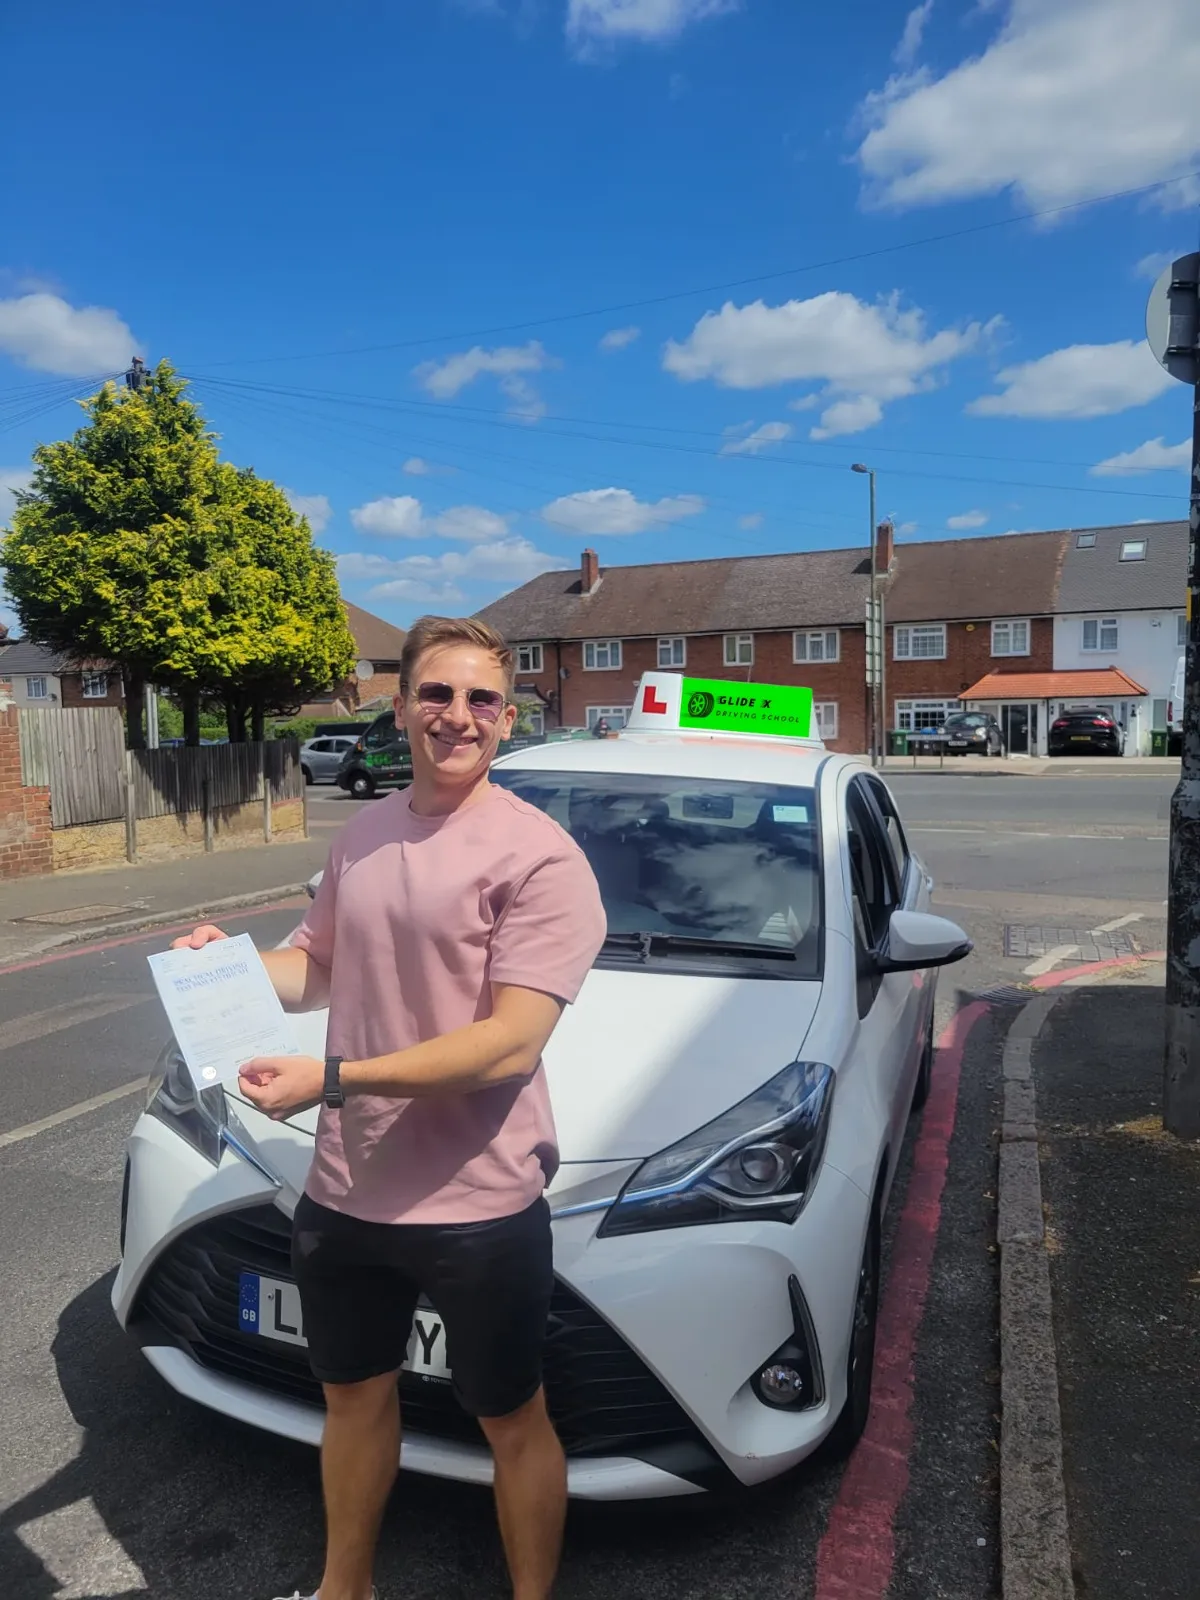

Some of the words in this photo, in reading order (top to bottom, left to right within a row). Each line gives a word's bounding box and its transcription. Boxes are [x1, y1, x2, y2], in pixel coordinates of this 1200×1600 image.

[643, 686, 667, 714] L
[717, 695, 756, 708] GLIDE
[762, 700, 772, 708] X
[716, 709, 757, 720] DRIVING
[761, 713, 800, 724] SCHOOL
[242, 1308, 257, 1322] GB
